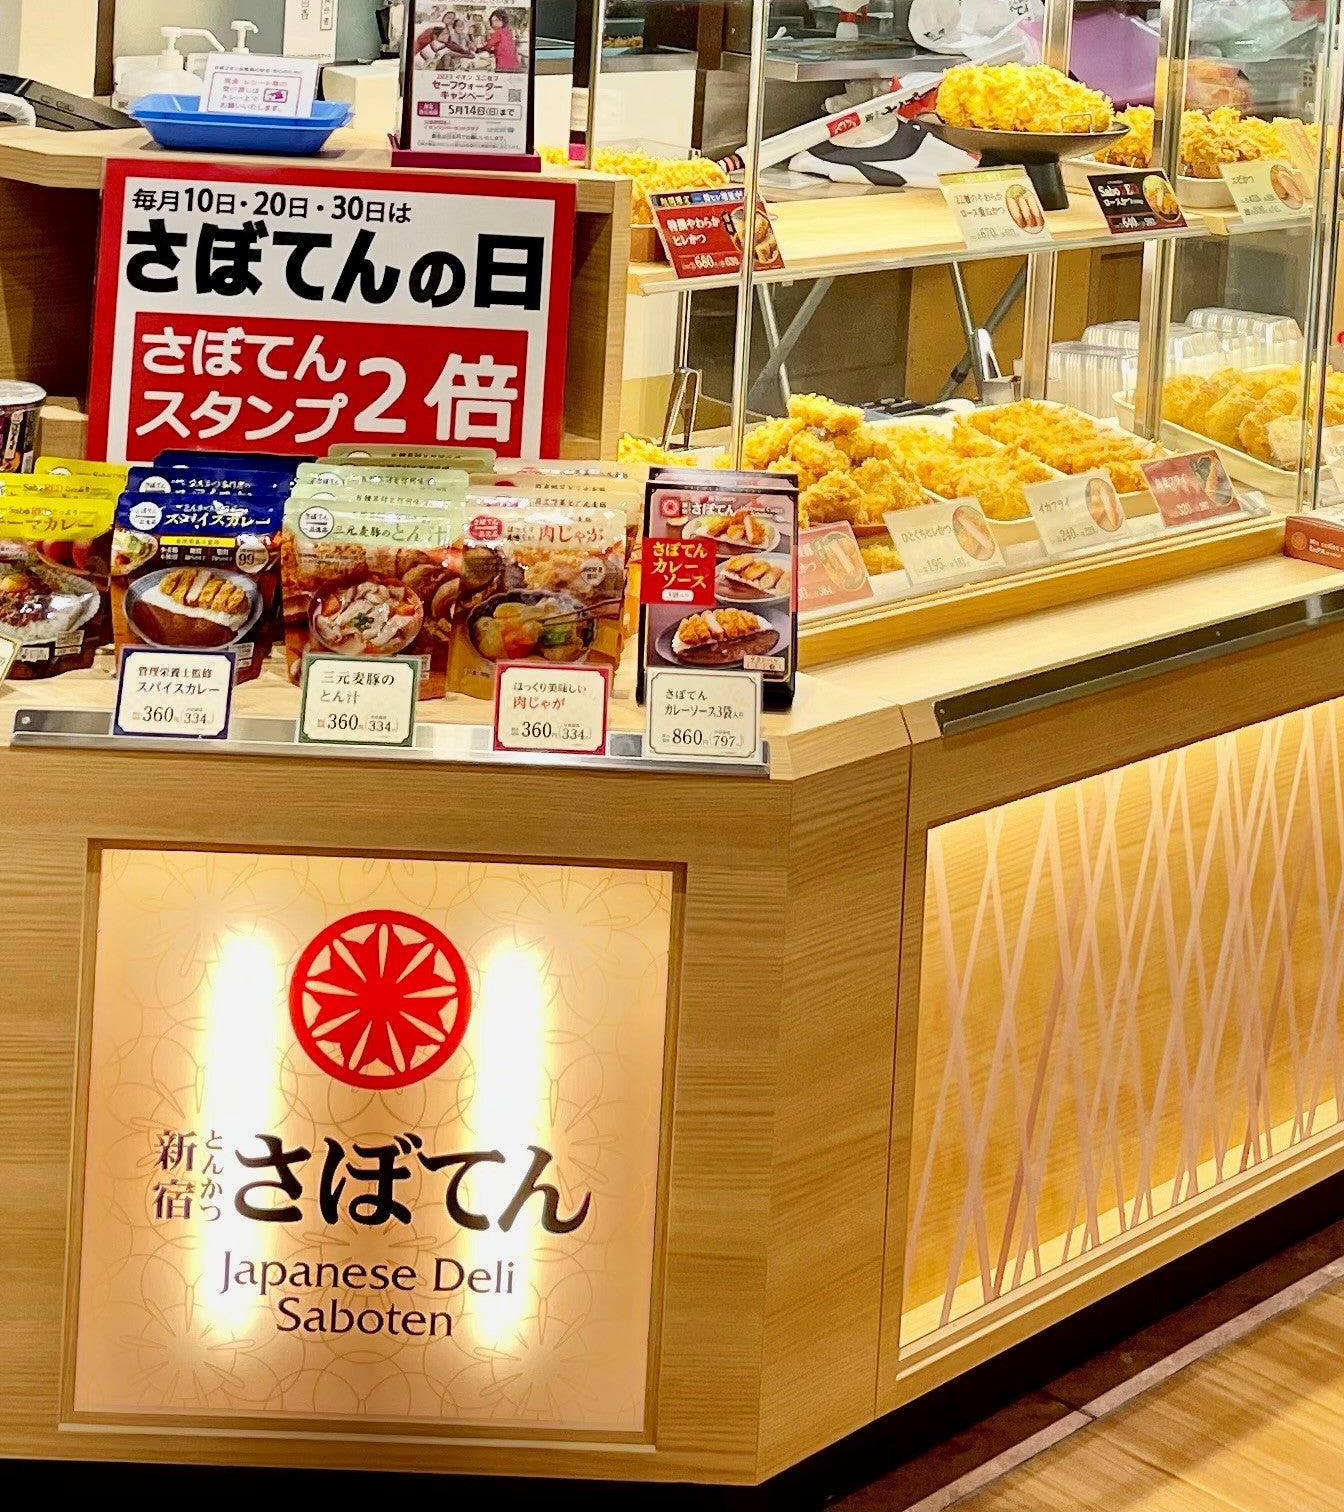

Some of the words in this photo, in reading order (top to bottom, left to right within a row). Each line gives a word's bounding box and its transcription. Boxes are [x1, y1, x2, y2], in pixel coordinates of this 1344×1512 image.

[432, 81, 503, 91] セーフウォーター
[440, 91, 494, 100] キャンペーン
[131, 187, 412, 225] 毎月10日・20日・30日は
[673, 234, 707, 246] ヒレかつ
[126, 218, 545, 311] さぼてんの日
[141, 325, 347, 381] さぼてん
[135, 390, 348, 443] スタンプ
[354, 353, 519, 443] 2倍
[692, 503, 736, 516] さぼてん
[539, 525, 604, 544] 肉じゃが
[652, 541, 708, 559] さぼてん
[651, 558, 698, 574] カレー
[663, 575, 707, 589] ソース
[321, 671, 394, 685] 三元麦豚の
[137, 682, 220, 695] スパイスカレー
[514, 682, 586, 693] ほっくり美味しい
[665, 689, 707, 700] さぼてん
[320, 690, 360, 704] とん汁
[513, 696, 565, 710] 肉じゃが
[142, 706, 174, 722] 360
[184, 713, 206, 724] 334
[328, 713, 358, 730] 360
[369, 721, 391, 731] 334
[522, 722, 552, 737] 360
[562, 728, 584, 740] 334
[672, 728, 703, 745] 860
[713, 736, 735, 747] 797
[152, 1129, 197, 1221] 新宿
[199, 1129, 224, 1222] とんかつ
[233, 1132, 591, 1235] さぼてん
[219, 1250, 417, 1296] Japanese
[434, 1259, 515, 1296] Deli
[276, 1298, 454, 1338] Saboten
